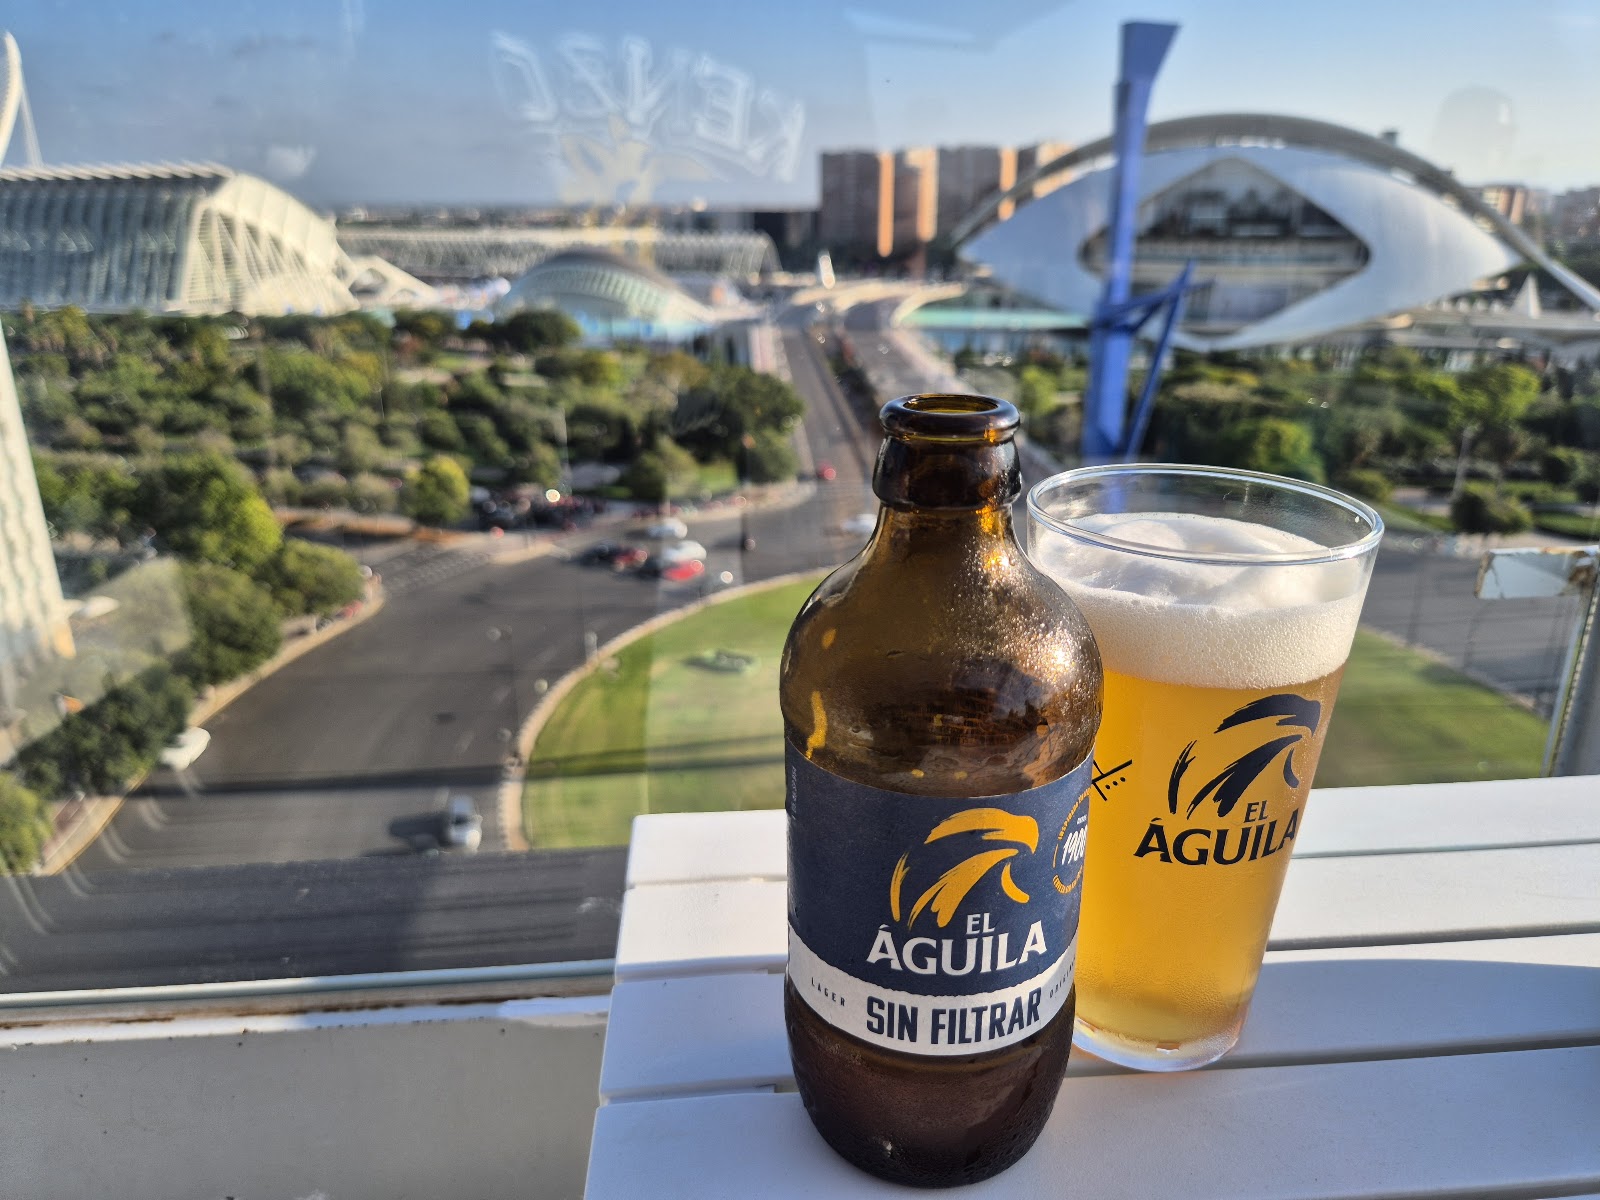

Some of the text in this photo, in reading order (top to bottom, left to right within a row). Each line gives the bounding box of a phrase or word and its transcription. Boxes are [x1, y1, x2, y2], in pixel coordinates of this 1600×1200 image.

[1244, 800, 1269, 823] EL
[1133, 808, 1299, 866] ÁGUILA
[966, 913, 995, 935] EL
[866, 920, 1047, 976] ÁGUILA
[811, 976, 845, 1007] LAGER
[866, 987, 1042, 1045] SIN FILTRAR
